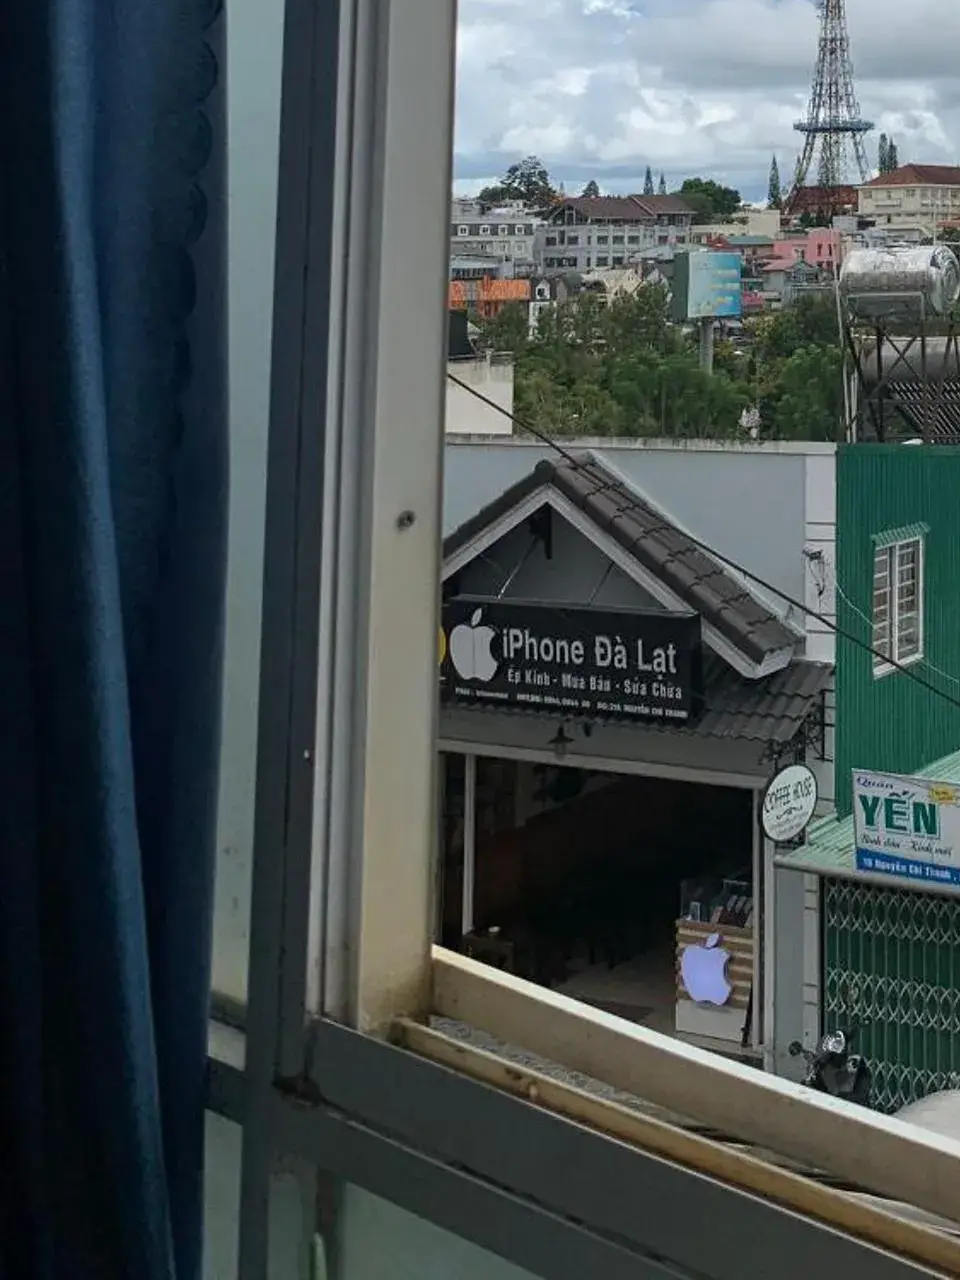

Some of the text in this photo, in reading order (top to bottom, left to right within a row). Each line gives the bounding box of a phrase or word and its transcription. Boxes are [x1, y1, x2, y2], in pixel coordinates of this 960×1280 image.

[502, 627, 677, 681] iPhone Đà Lạt
[858, 789, 938, 835] YẾN
